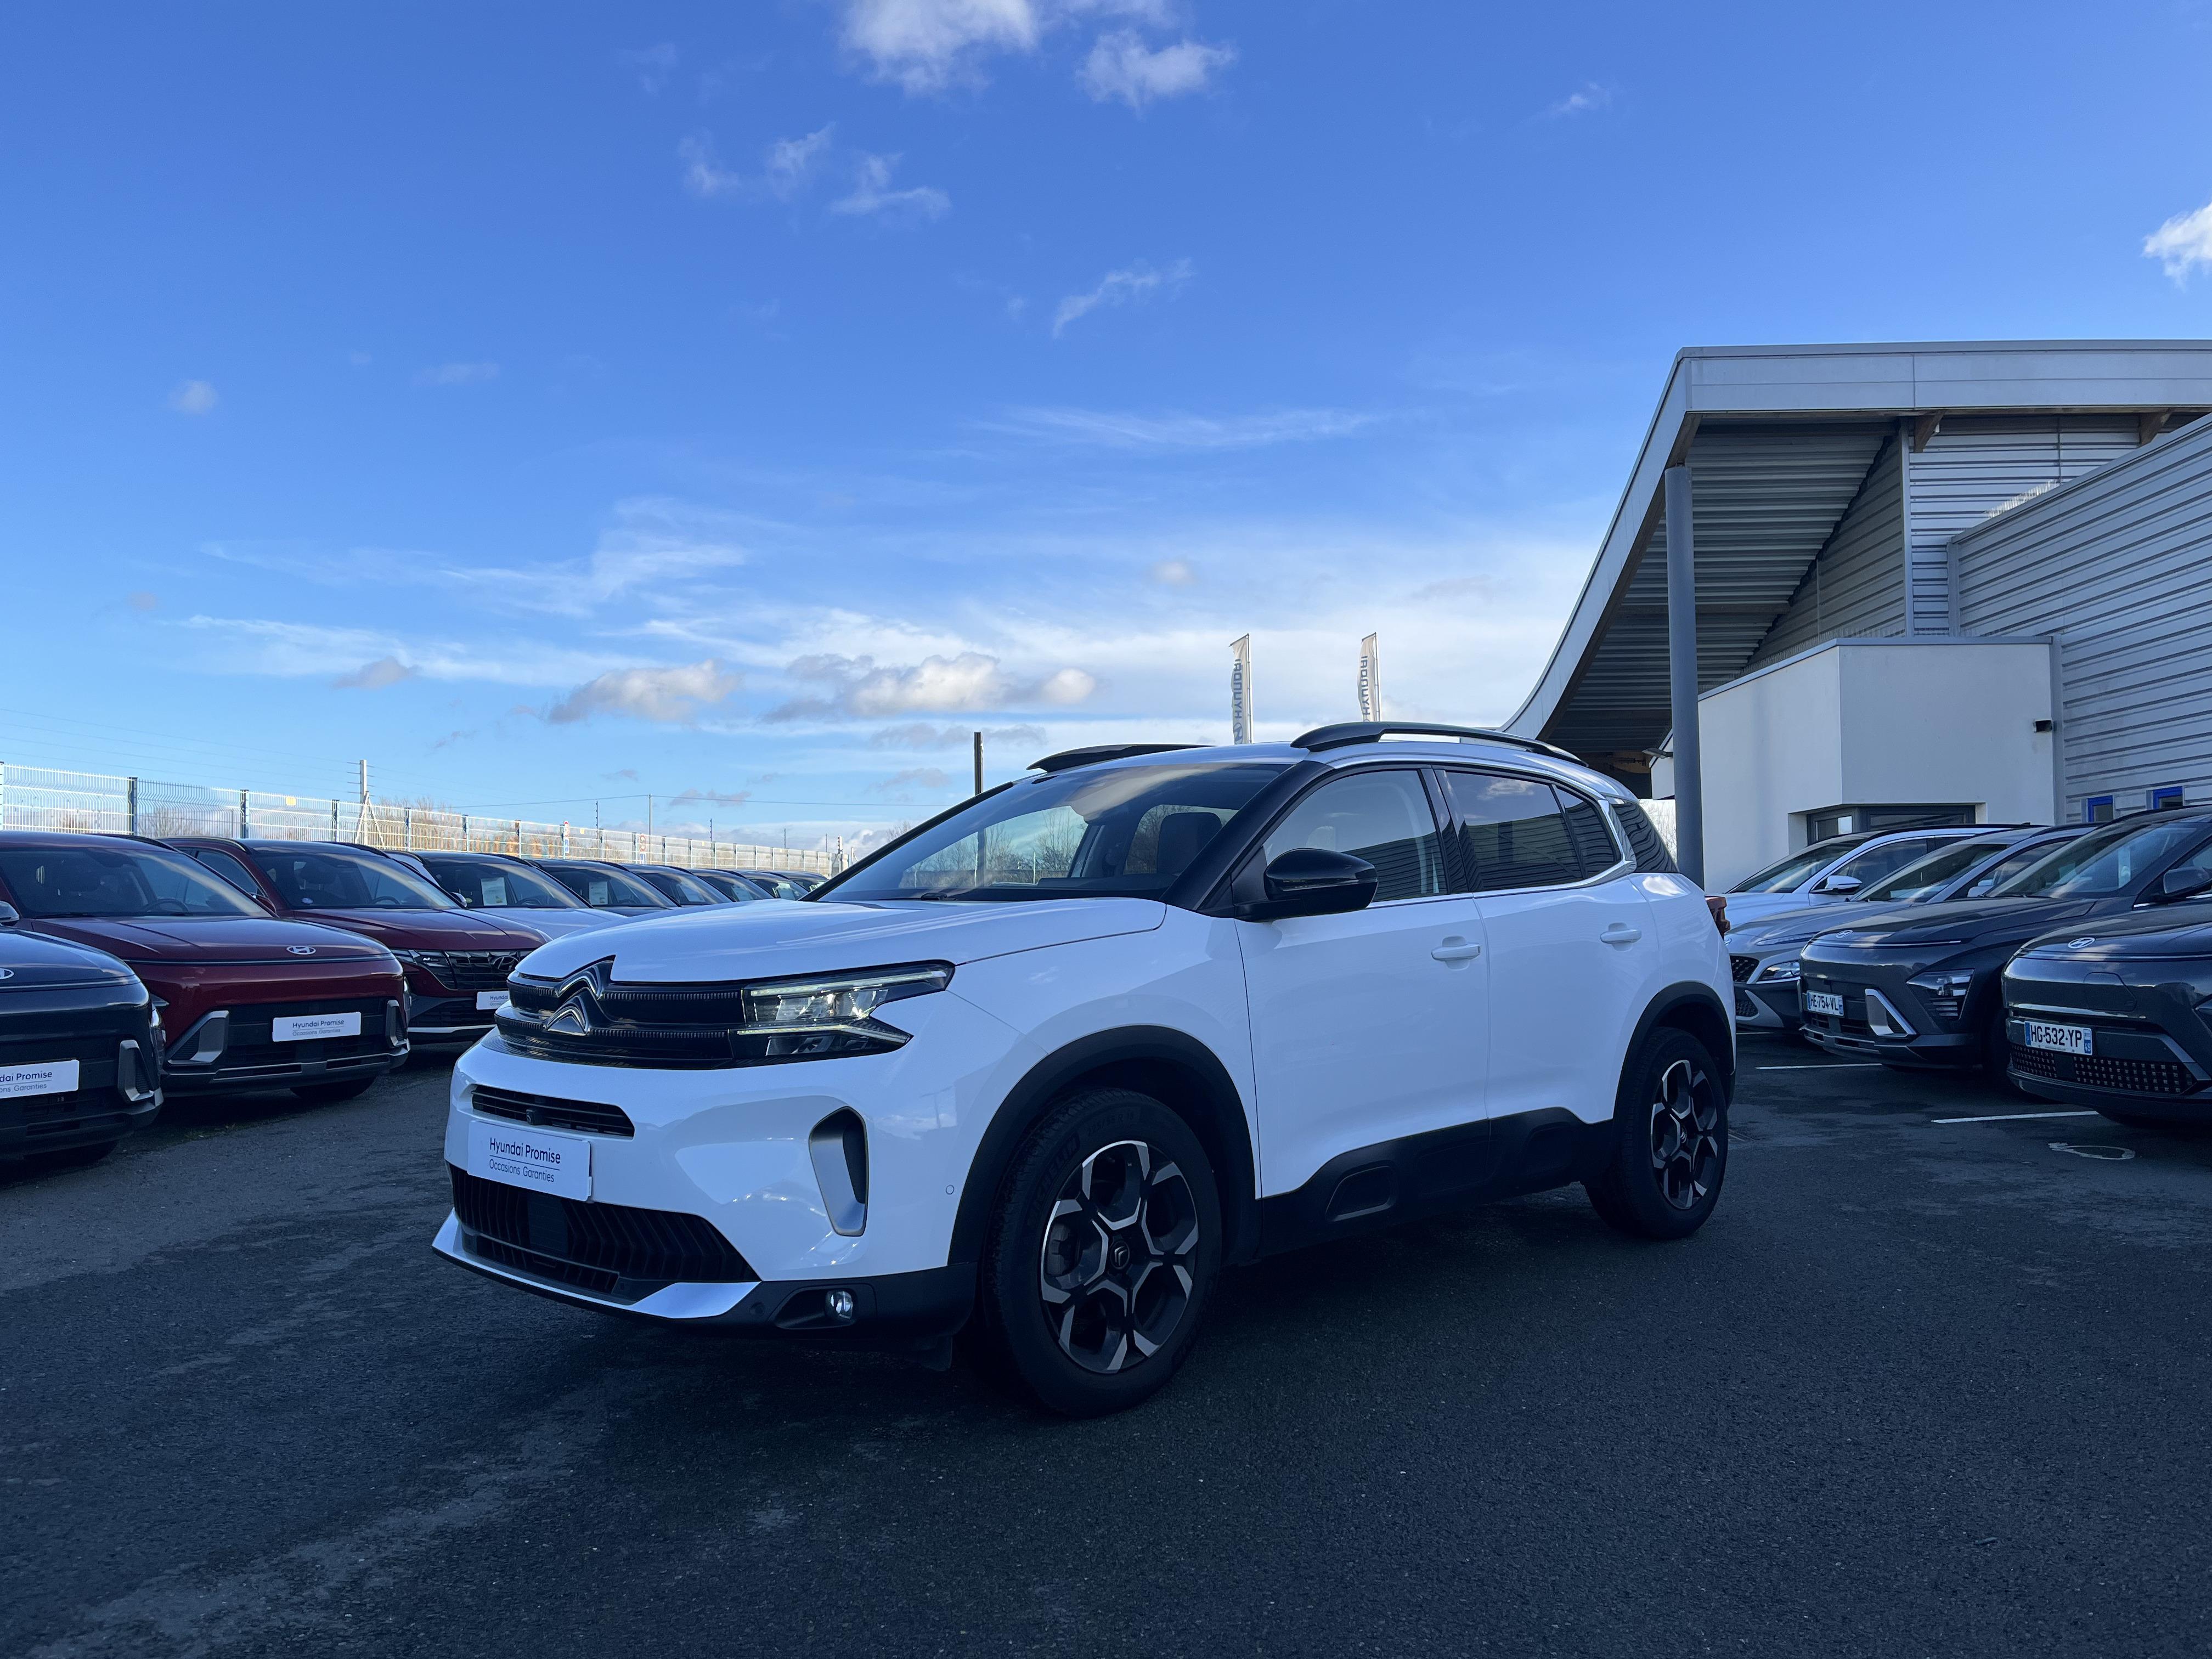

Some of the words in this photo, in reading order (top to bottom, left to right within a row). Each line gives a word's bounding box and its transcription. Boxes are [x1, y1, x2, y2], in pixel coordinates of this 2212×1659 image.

[2030, 1024, 2083, 1048] HG-532-YP
[14, 1082, 47, 1092] Garanties
[16, 1070, 53, 1081] Promise
[489, 1137, 523, 1157] Hyundai
[525, 1146, 561, 1164] Promise
[489, 1159, 521, 1176] Occasions
[523, 1166, 555, 1183] Garanties
